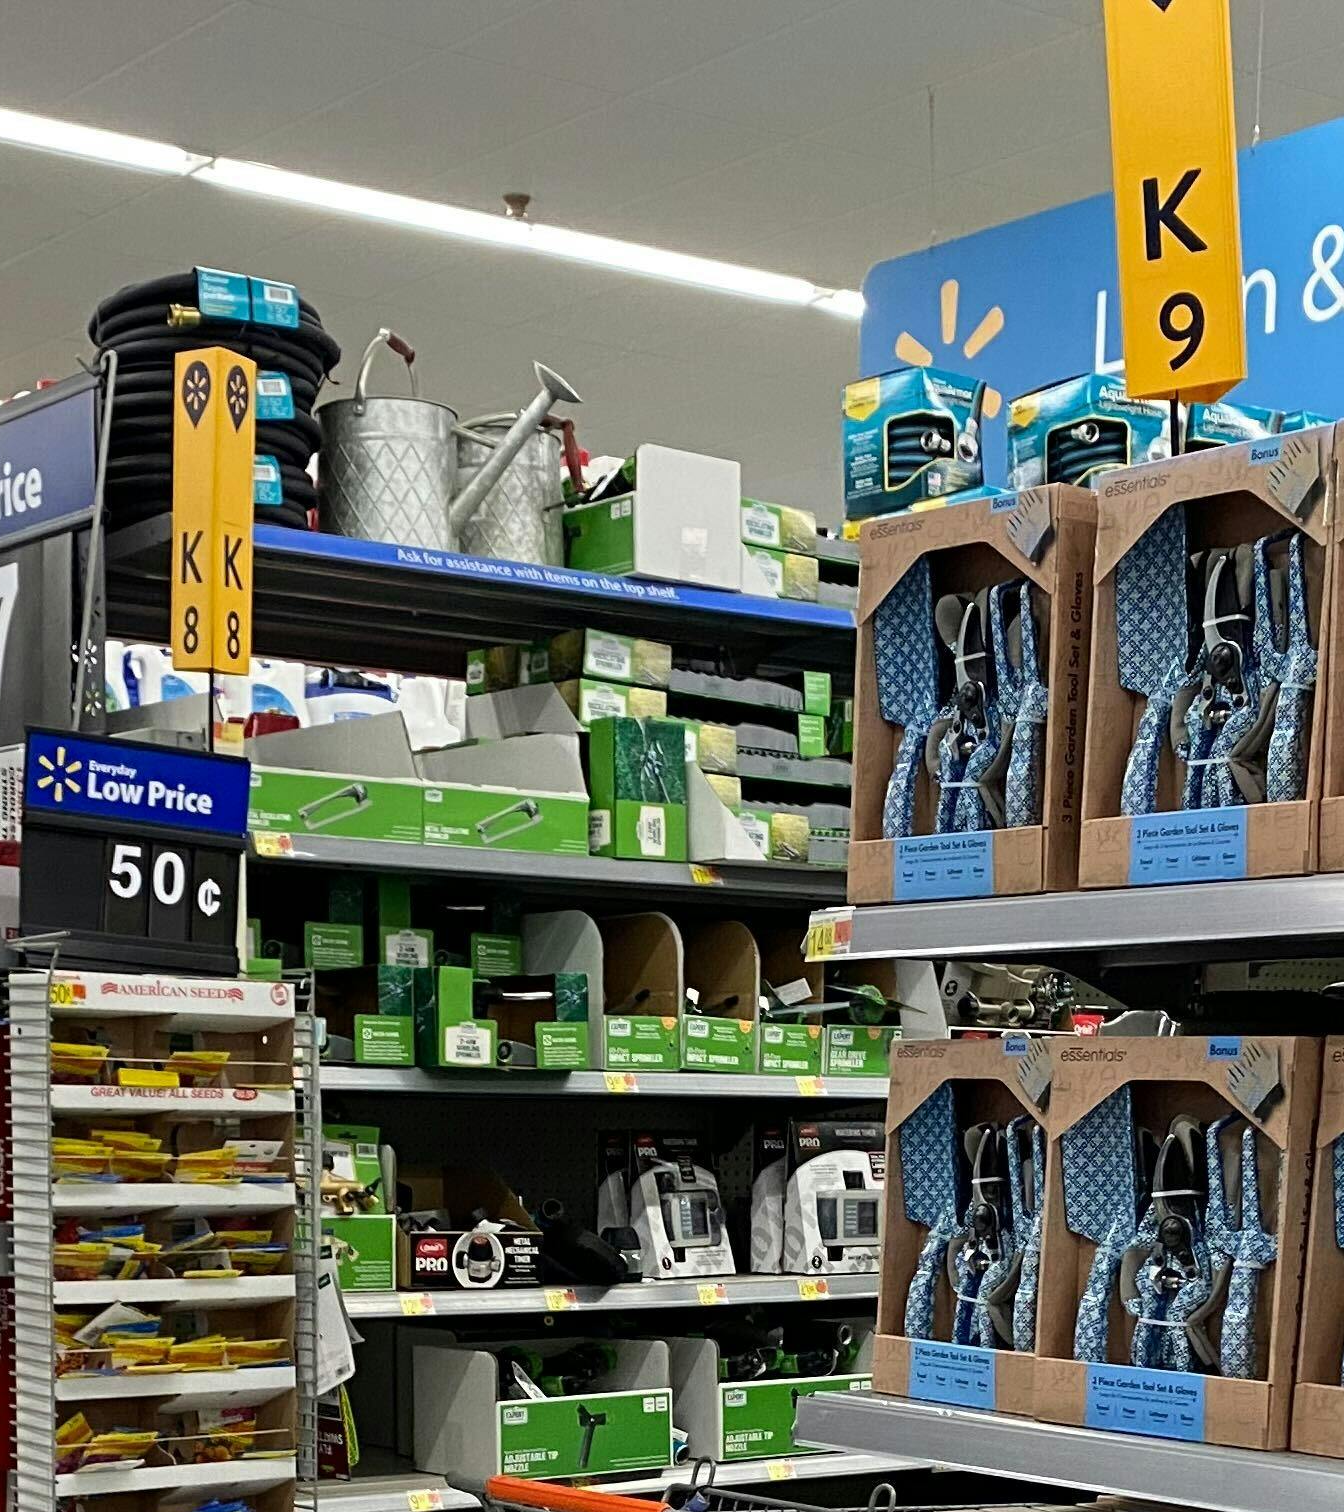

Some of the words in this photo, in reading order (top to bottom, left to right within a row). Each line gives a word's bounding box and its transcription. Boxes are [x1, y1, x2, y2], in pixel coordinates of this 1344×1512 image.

[1143, 168, 1208, 261] K
[1095, 267, 1277, 373] Ln
[1158, 292, 1206, 371] 9
[1251, 448, 1279, 461] Bonus
[1105, 475, 1169, 498] essentials
[182, 530, 205, 586] K
[224, 537, 244, 591] K
[397, 548, 423, 563] Ask
[423, 553, 444, 568] for
[447, 556, 513, 577] assistance
[513, 567, 544, 581] with
[545, 570, 581, 586] items
[581, 577, 599, 589] on
[599, 577, 621, 592] the
[622, 582, 646, 598] top
[647, 584, 681, 601] shelf.
[182, 608, 201, 655] 8
[225, 610, 241, 661] 8
[88, 760, 138, 778] Everyday
[87, 773, 144, 804] Low
[149, 780, 214, 814] Price
[117, 982, 187, 998] AMERICAN
[190, 987, 228, 999] SEED
[1060, 1046, 1123, 1063] essentials
[1208, 1043, 1240, 1057] Bonus
[91, 1086, 128, 1098] GREAT
[191, 1087, 224, 1099] SEEDS
[798, 1138, 821, 1148] PRO
[415, 1257, 448, 1272] PRO
